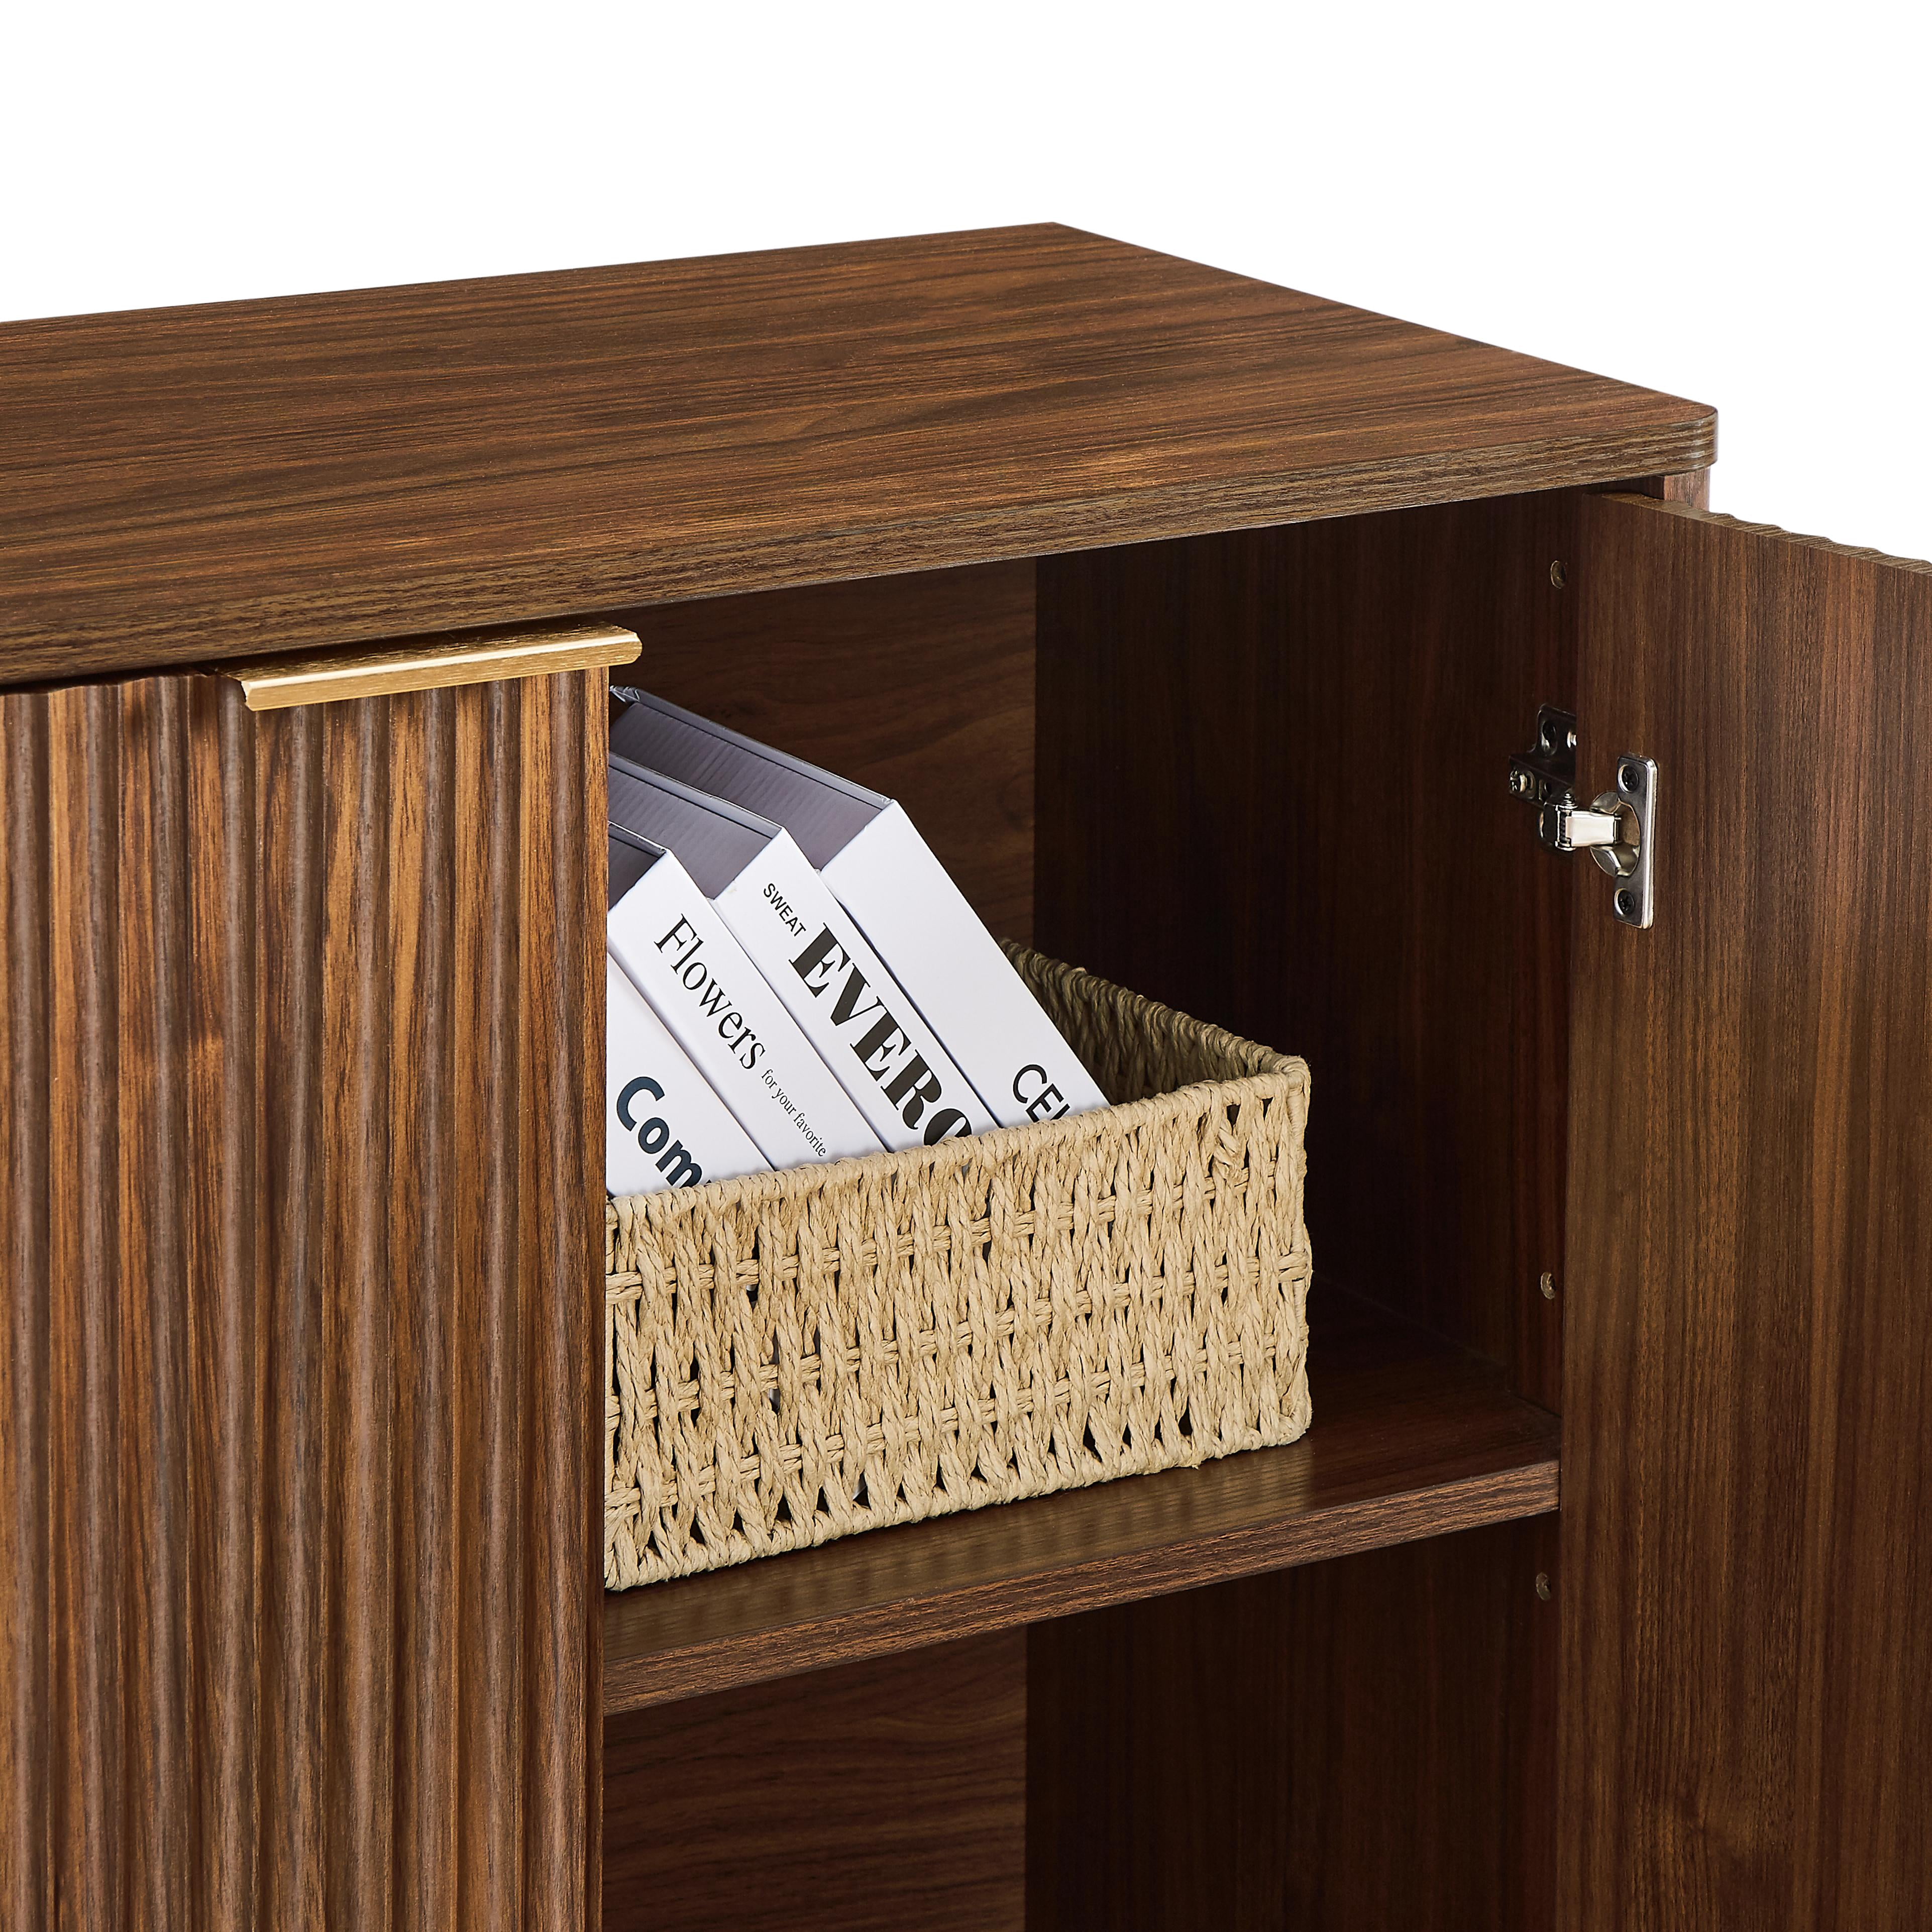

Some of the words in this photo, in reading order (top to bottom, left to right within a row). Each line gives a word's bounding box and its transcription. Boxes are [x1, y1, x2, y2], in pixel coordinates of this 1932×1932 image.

[763, 883, 807, 937] SWEAT
[654, 913, 766, 1069] Flowers
[761, 1069, 777, 1090] for
[771, 1088, 797, 1115] your
[793, 1112, 826, 1157] favorite
[616, 1076, 712, 1189] Com
